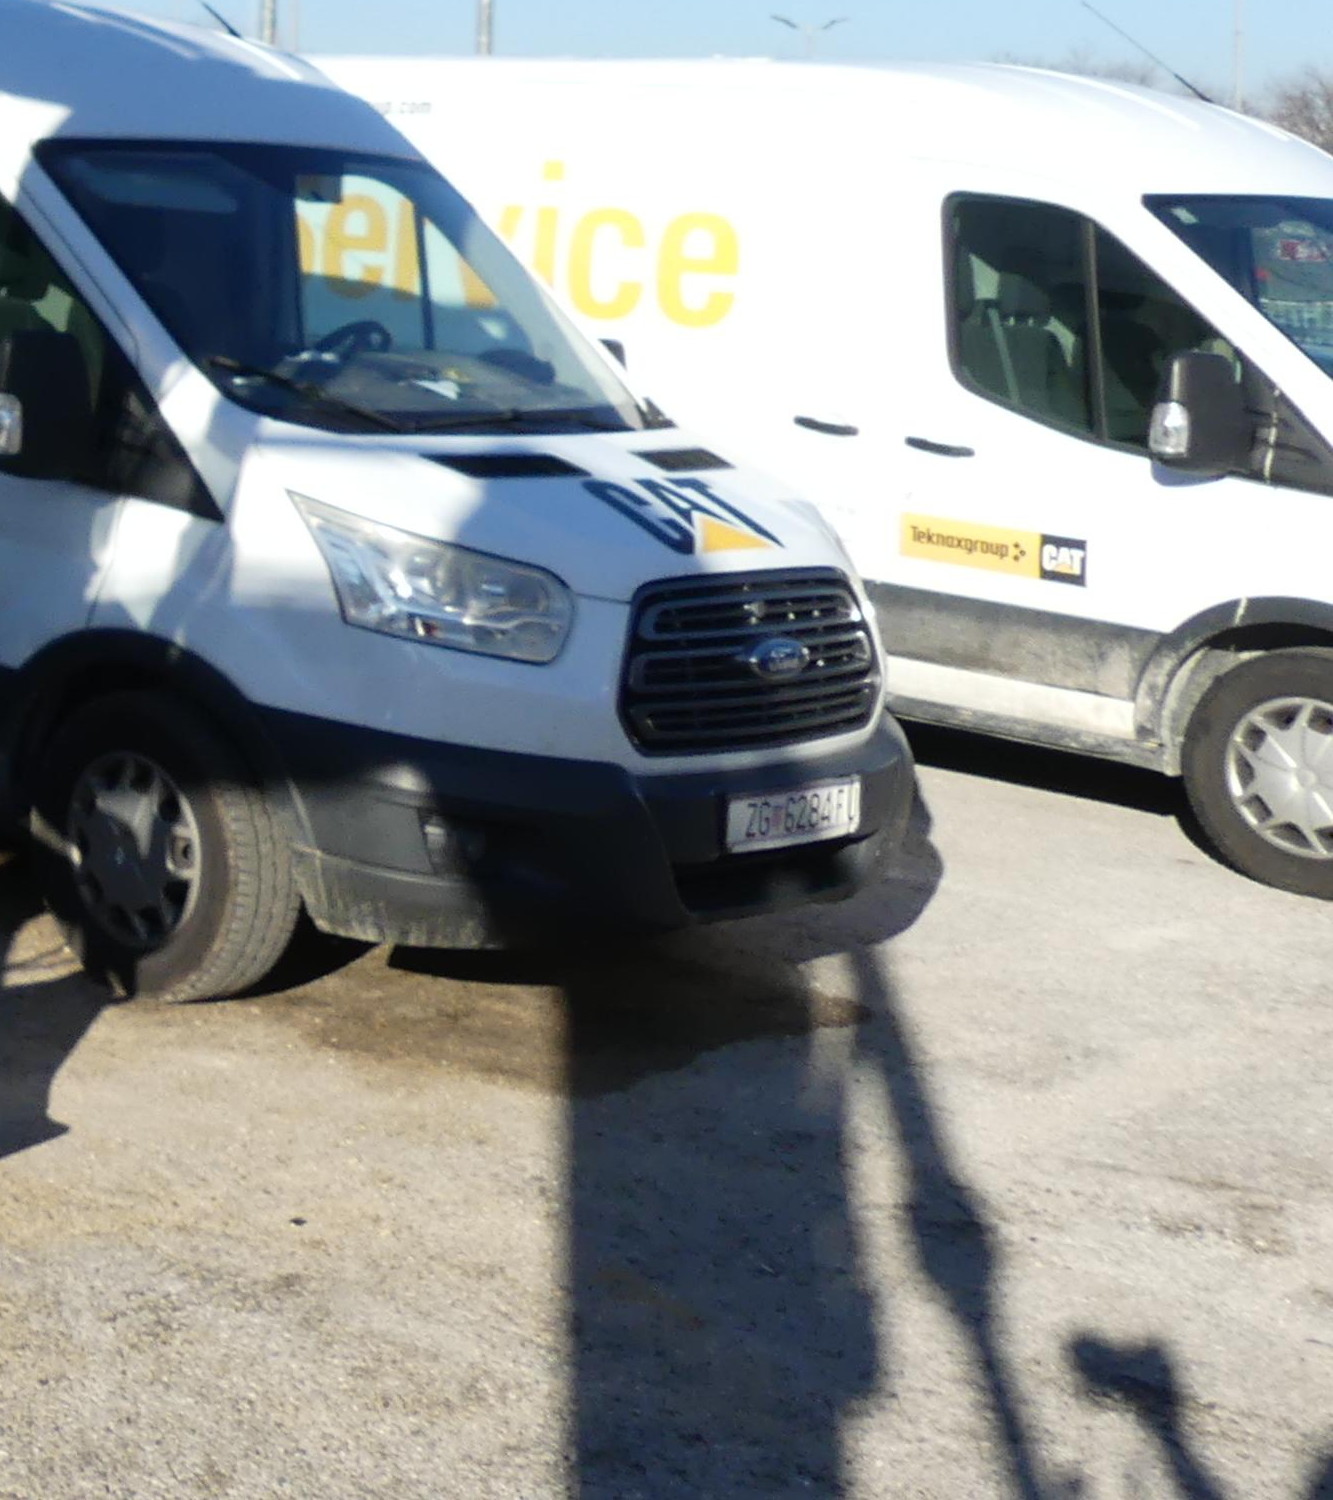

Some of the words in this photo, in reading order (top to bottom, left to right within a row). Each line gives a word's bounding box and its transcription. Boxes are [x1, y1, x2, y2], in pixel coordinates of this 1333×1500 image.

[581, 477, 786, 556] CAT
[909, 524, 1010, 560] Teknoxgroup
[1041, 543, 1085, 576] CAT
